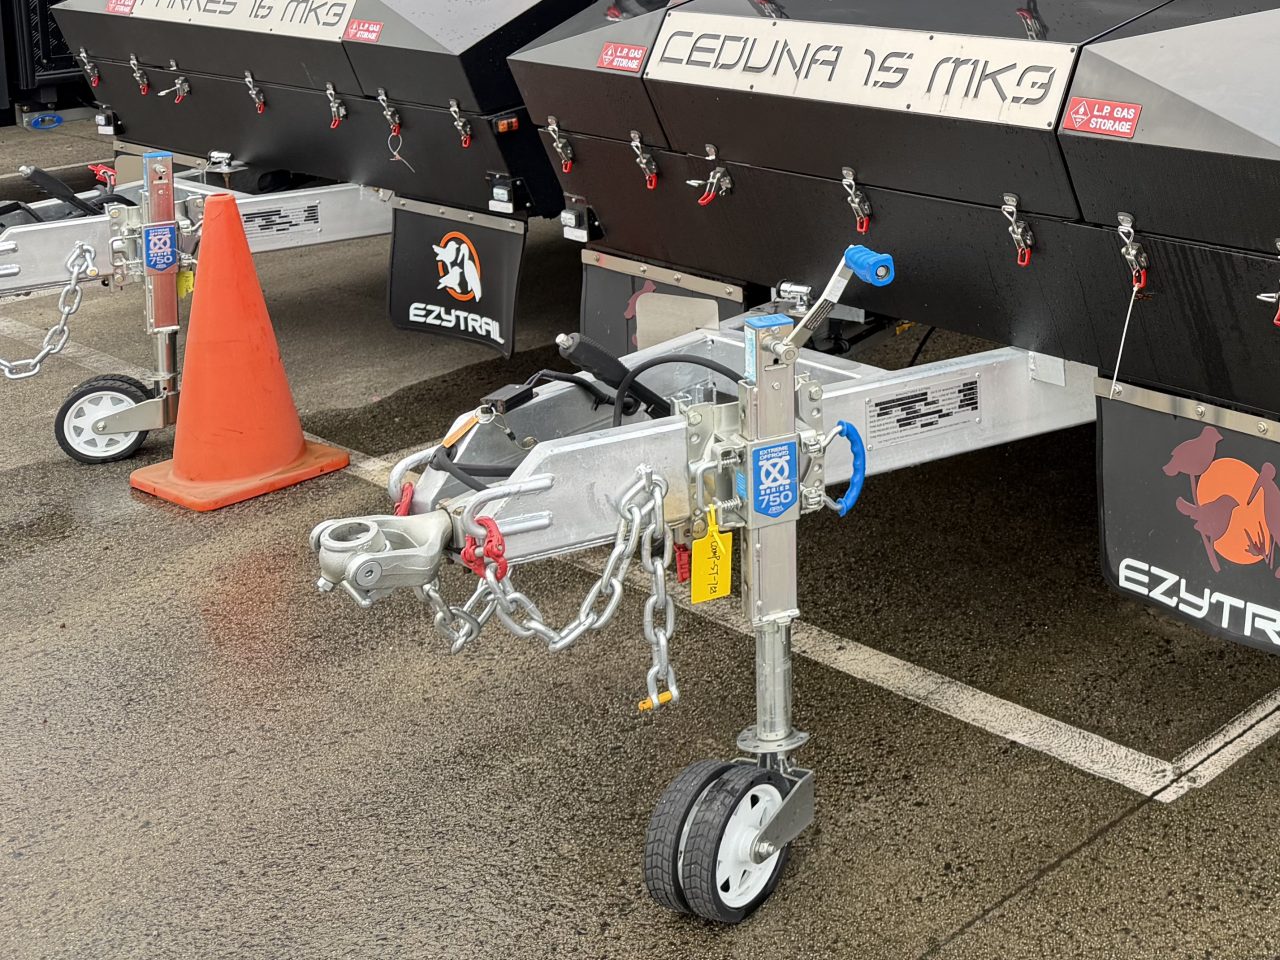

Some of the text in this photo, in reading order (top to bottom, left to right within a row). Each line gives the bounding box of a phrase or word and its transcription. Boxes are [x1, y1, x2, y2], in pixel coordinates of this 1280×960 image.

[628, 49, 643, 59] GAS
[659, 30, 844, 82] CEDUNA
[612, 57, 640, 69] STORAGE
[1093, 104, 1136, 119] L.P. GAS
[1089, 117, 1133, 133] STORAGE
[148, 255, 173, 265] 750
[409, 302, 505, 344] EZYTRAIL
[758, 490, 793, 509] 750
